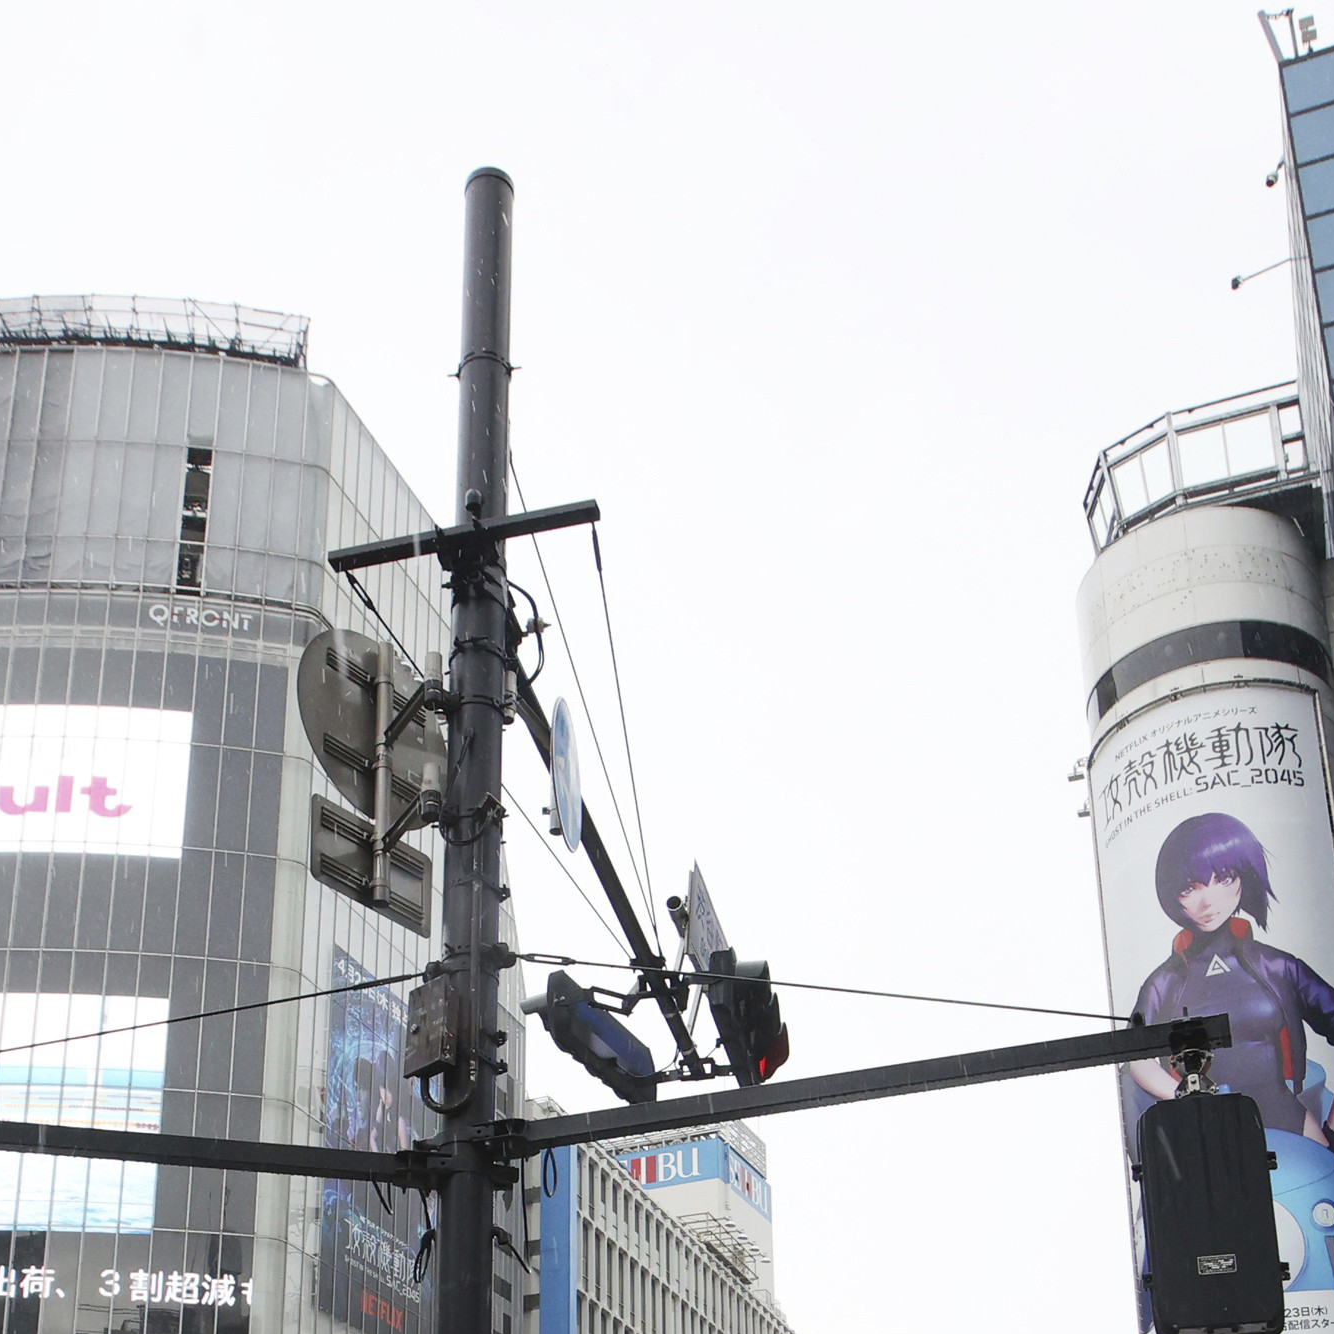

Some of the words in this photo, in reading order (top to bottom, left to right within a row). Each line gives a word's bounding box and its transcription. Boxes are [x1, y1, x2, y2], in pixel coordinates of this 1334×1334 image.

[148, 604, 253, 632] QFRONT
[1114, 734, 1149, 762] NETFLIX
[1150, 706, 1257, 738] オリジナルアニメシリーズ
[1099, 722, 1303, 832] 攻殻機動隊
[1134, 804, 1153, 820] THE
[1154, 786, 1194, 809] SHELL:
[1195, 768, 1306, 793] SAC_2045
